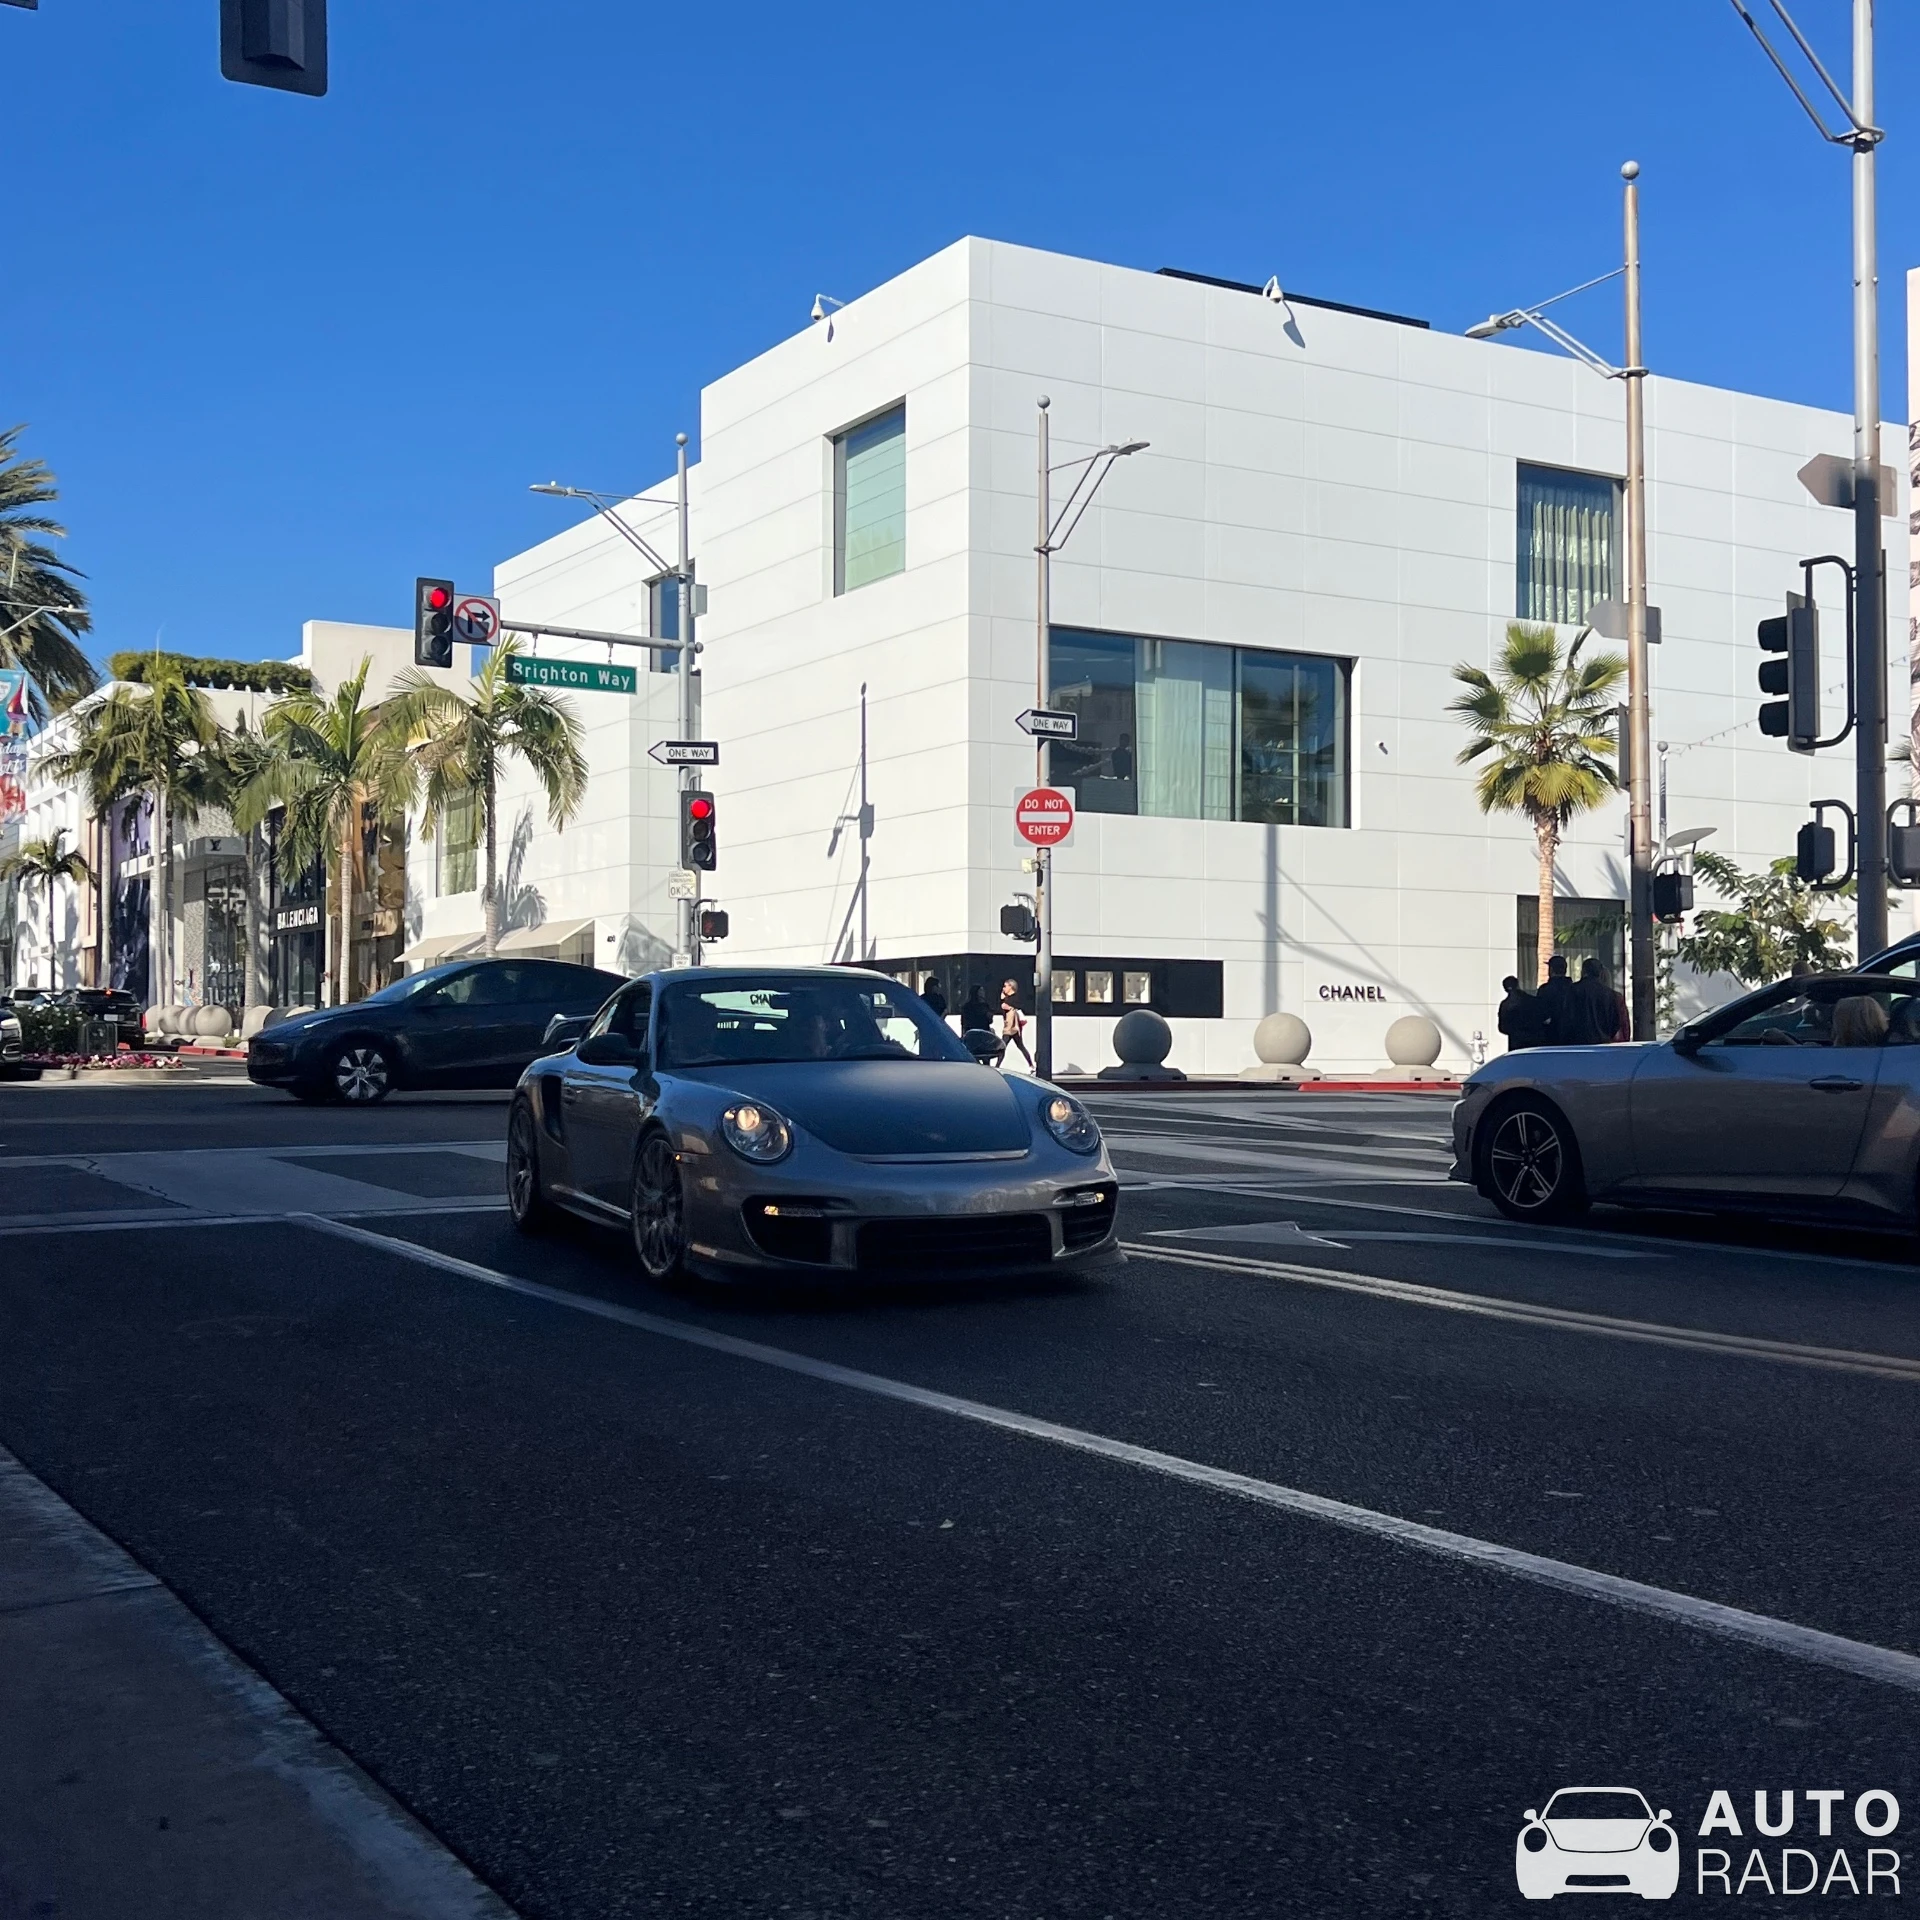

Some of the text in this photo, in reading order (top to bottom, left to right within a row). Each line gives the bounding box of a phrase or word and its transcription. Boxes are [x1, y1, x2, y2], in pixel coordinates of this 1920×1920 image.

[512, 662, 630, 690] Brighton Way
[1033, 718, 1069, 730] ONE WAY
[668, 748, 710, 758] ONE WAY
[1024, 799, 1064, 809] DO NOT
[1028, 825, 1060, 836] ENTER
[670, 887, 681, 896] OK
[277, 906, 319, 930] BALENCIAGA
[1318, 984, 1385, 1000] CHANEL
